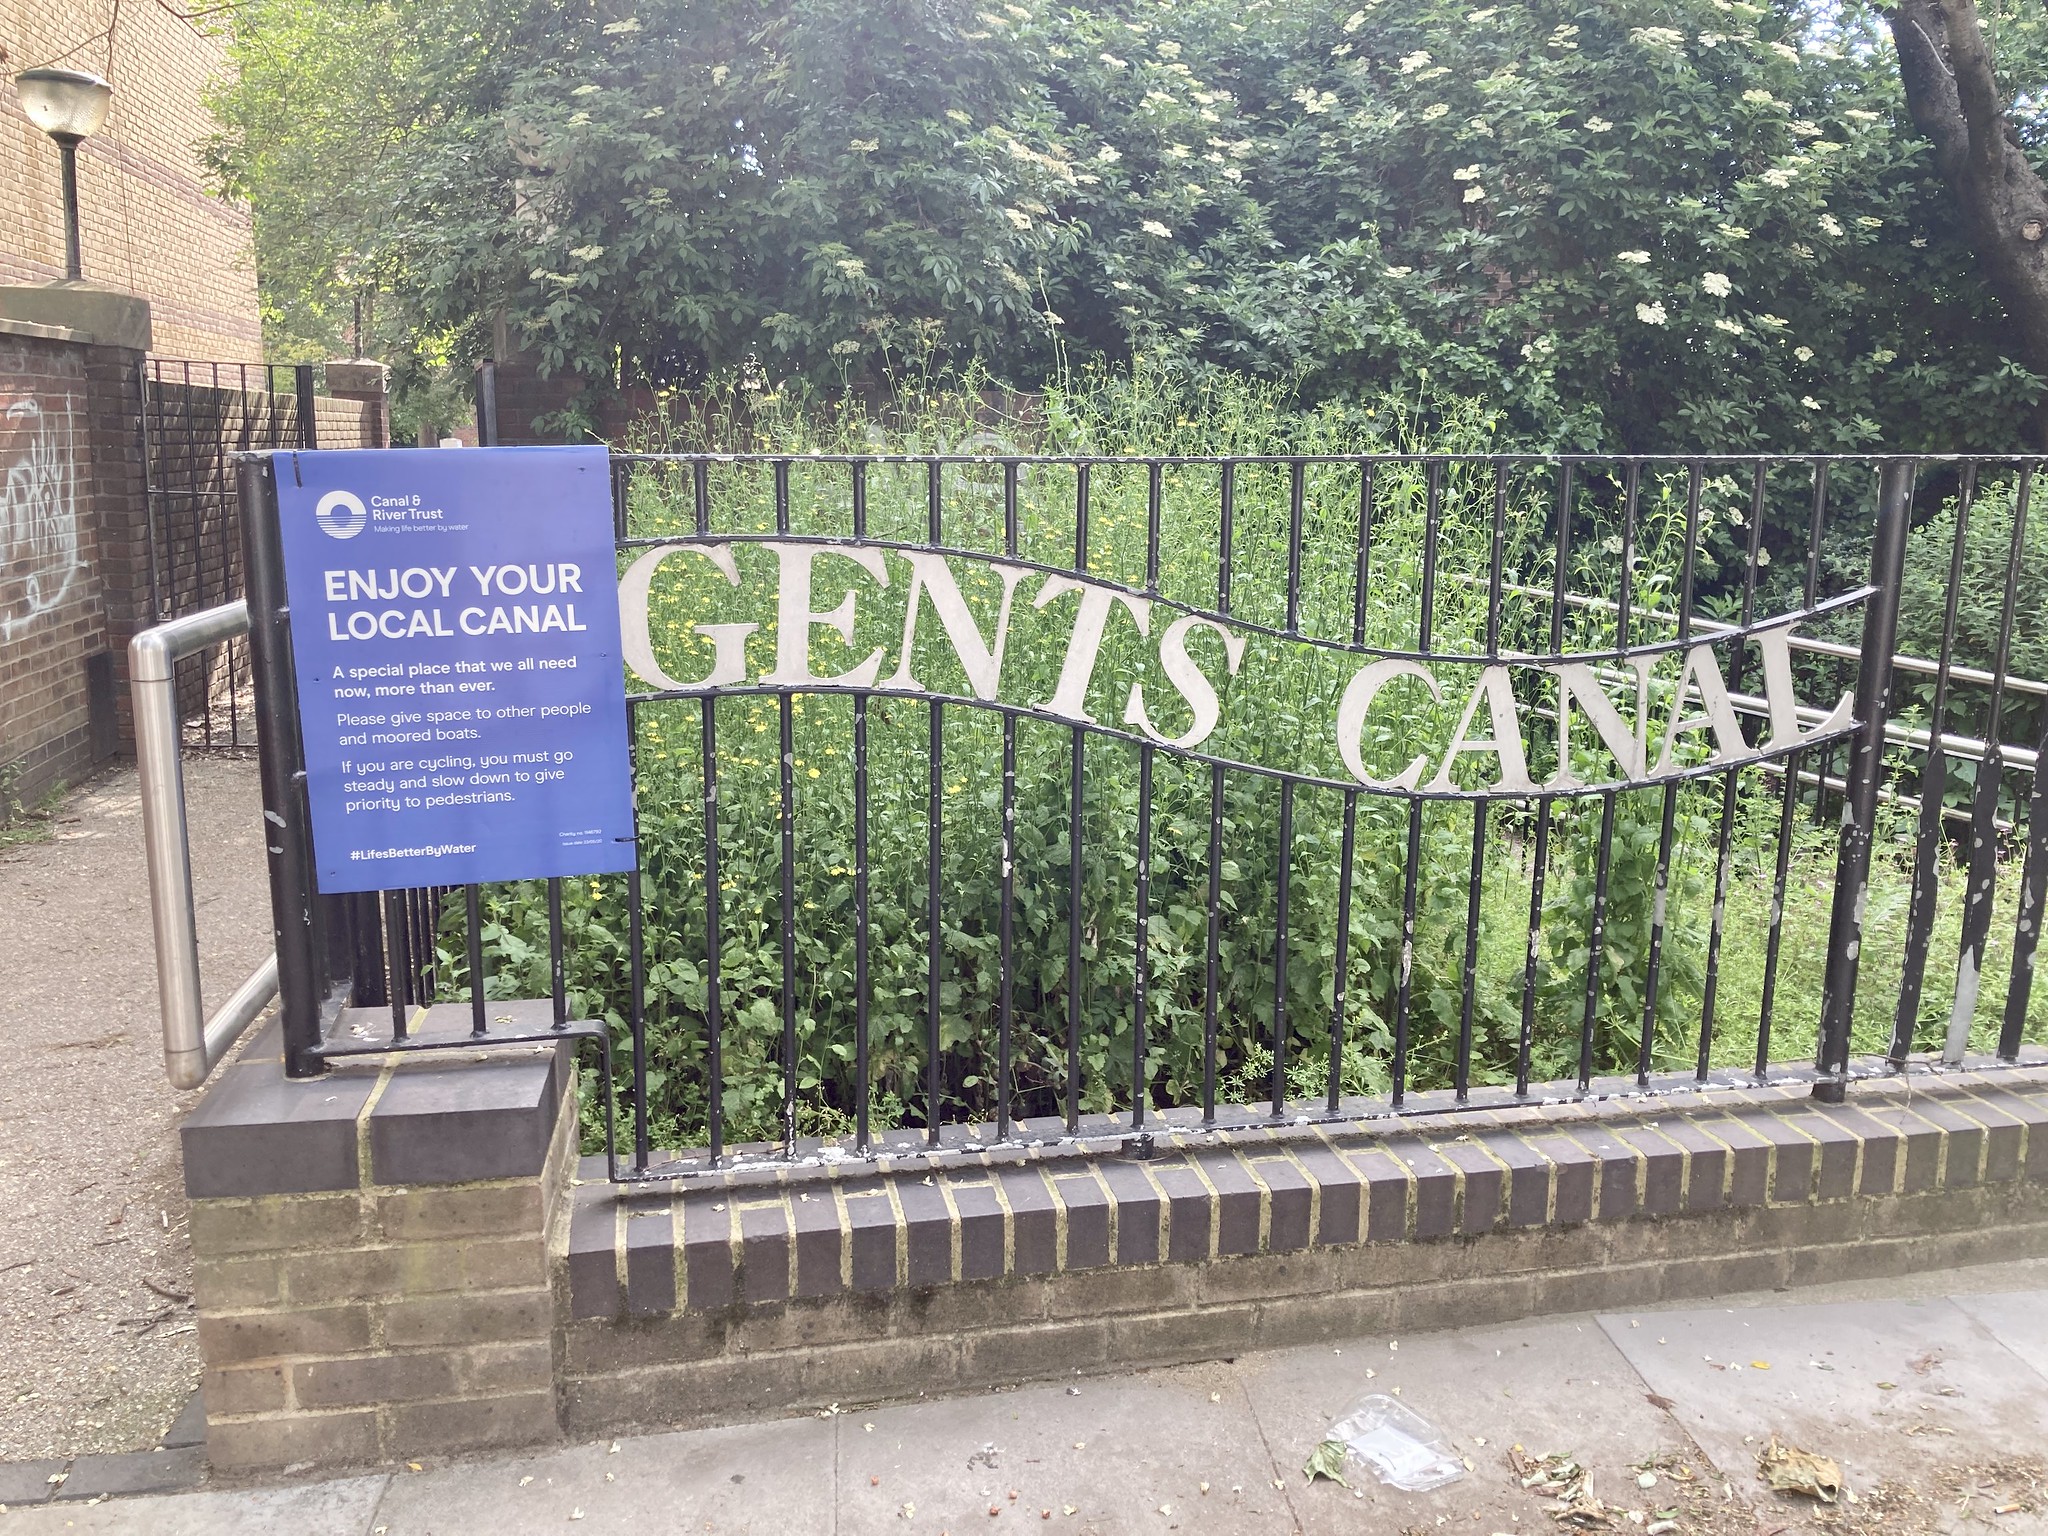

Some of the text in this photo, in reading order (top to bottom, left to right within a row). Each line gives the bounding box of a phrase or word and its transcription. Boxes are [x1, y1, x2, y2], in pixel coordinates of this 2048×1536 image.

[371, 495, 421, 507] Canal &
[373, 508, 443, 520] River Trust
[374, 525, 400, 534] Making
[401, 524, 412, 532] life
[437, 524, 448, 532] by
[324, 564, 583, 601] ENJOY YOUR
[328, 604, 586, 640] LOCAL CANAL
[333, 656, 576, 680] A special place that we all need
[334, 682, 495, 698] now, more than ever.
[337, 702, 591, 727] Please give space to other people
[1337, 622, 1854, 793] CANAL
[340, 728, 481, 745] and moored boats.
[342, 751, 573, 776] If you are cycling, you must go
[344, 769, 564, 793] steady and slow down to give
[346, 791, 515, 814] priority to pedestrians.
[350, 844, 476, 860] #LifesBetterByWater
